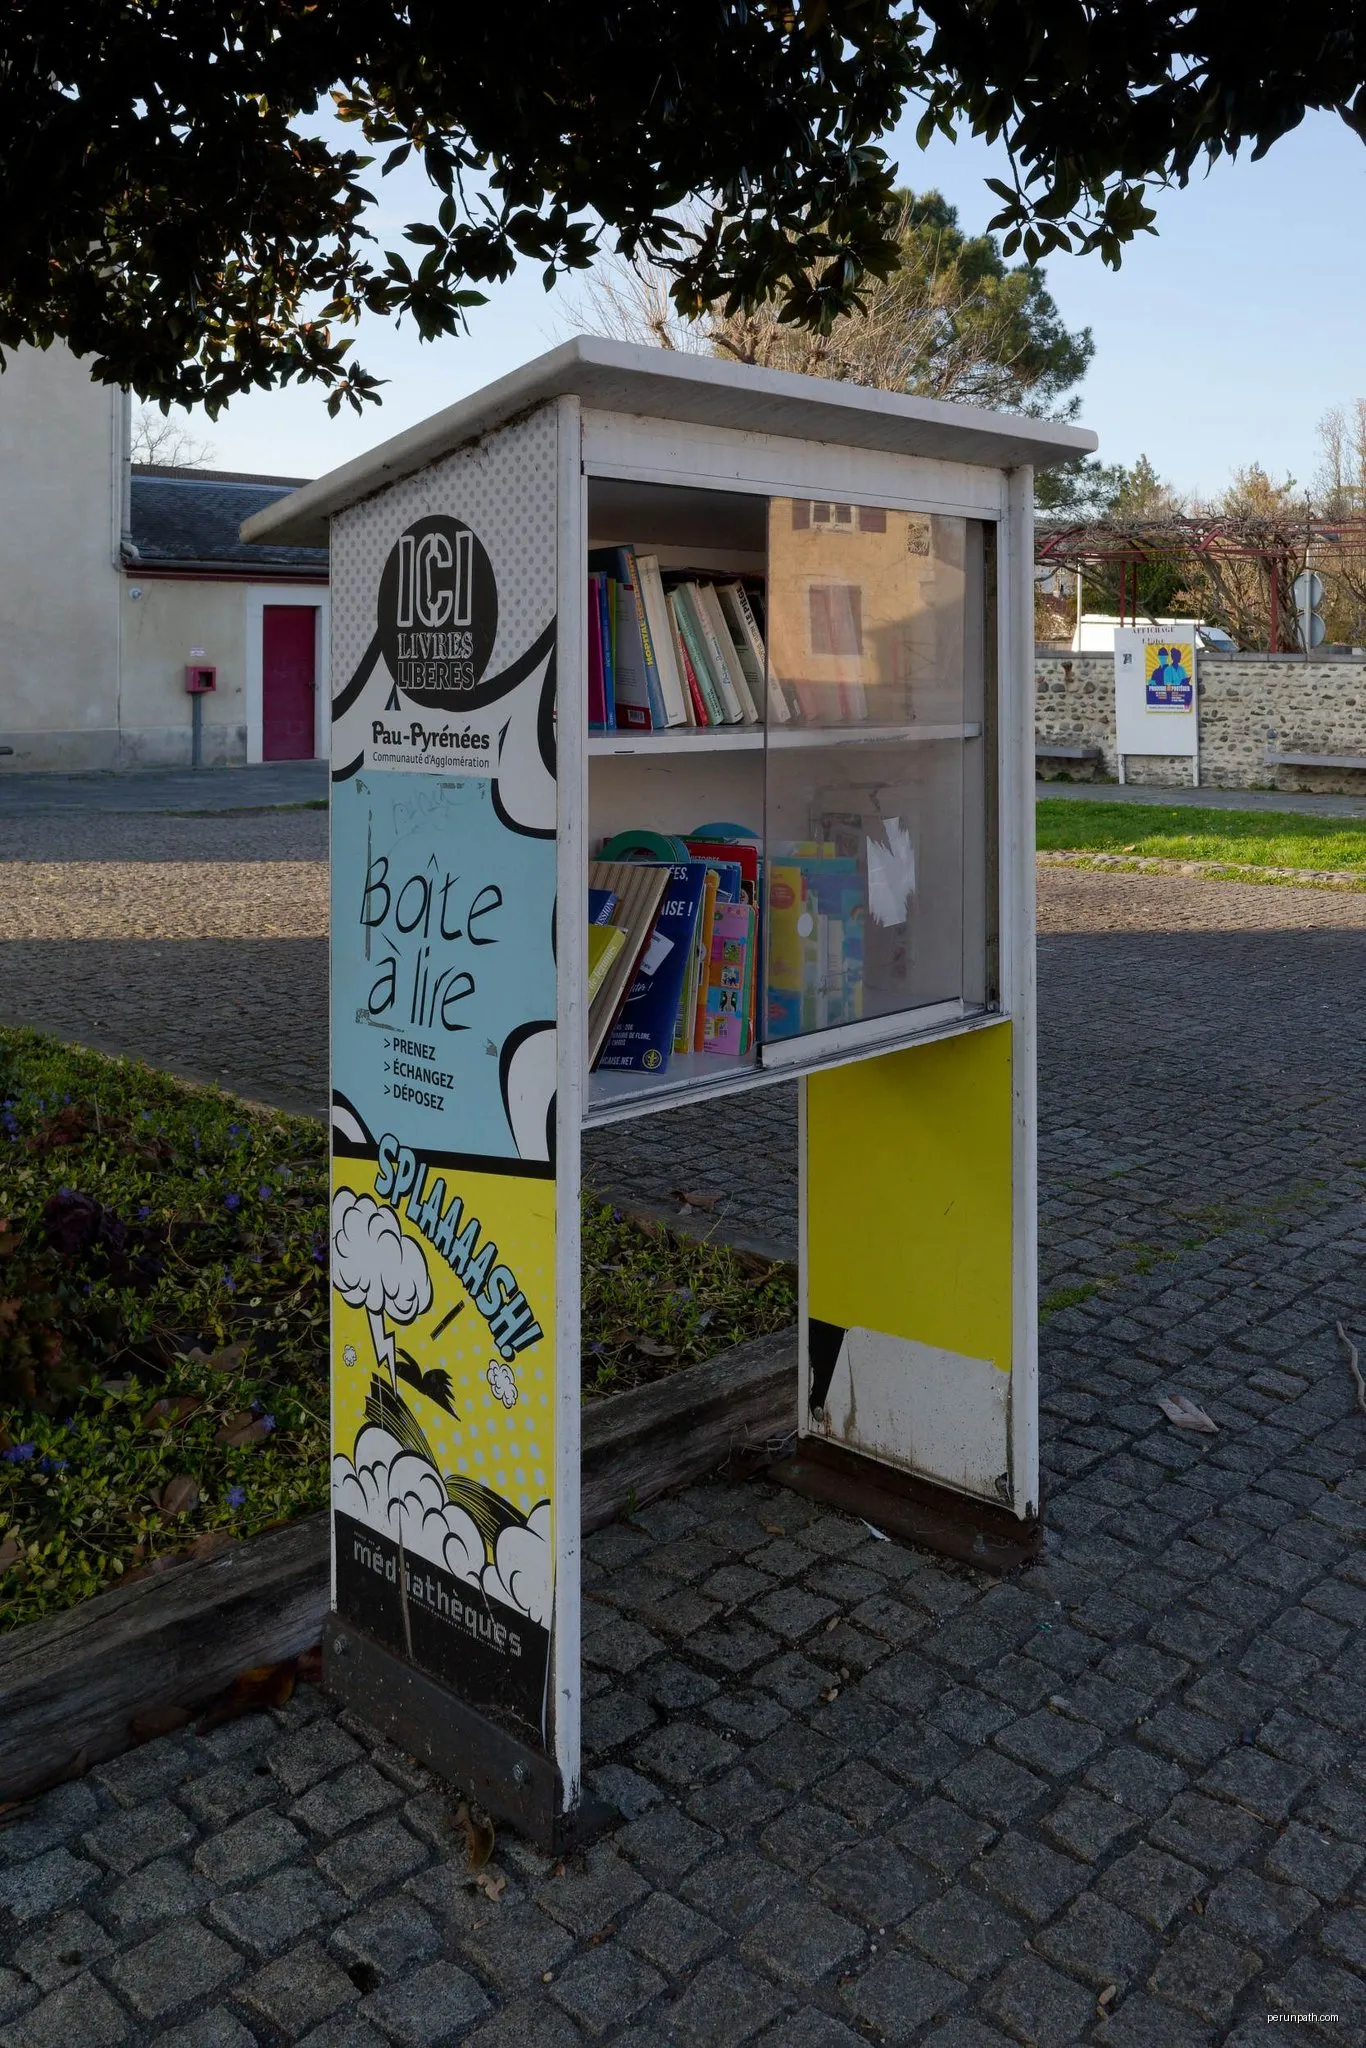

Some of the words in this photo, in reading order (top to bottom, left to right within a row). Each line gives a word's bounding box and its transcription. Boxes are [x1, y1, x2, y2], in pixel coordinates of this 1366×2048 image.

[396, 530, 474, 628] ICI
[397, 631, 474, 660] LIVRES
[397, 661, 475, 691] LIBERES
[371, 720, 490, 753] Pau-Pyrénées
[372, 751, 423, 764] Communauté
[424, 755, 490, 769] d'Agglomération
[360, 852, 503, 946] Boîte
[368, 932, 402, 1015] à
[410, 946, 476, 1032] lire
[393, 1037, 436, 1061] PRENEZ
[393, 1059, 455, 1090] ÉCHANGEZ
[393, 1083, 445, 1112] DÉPOSEZ
[374, 1132, 545, 1363] SPLAAAASH!
